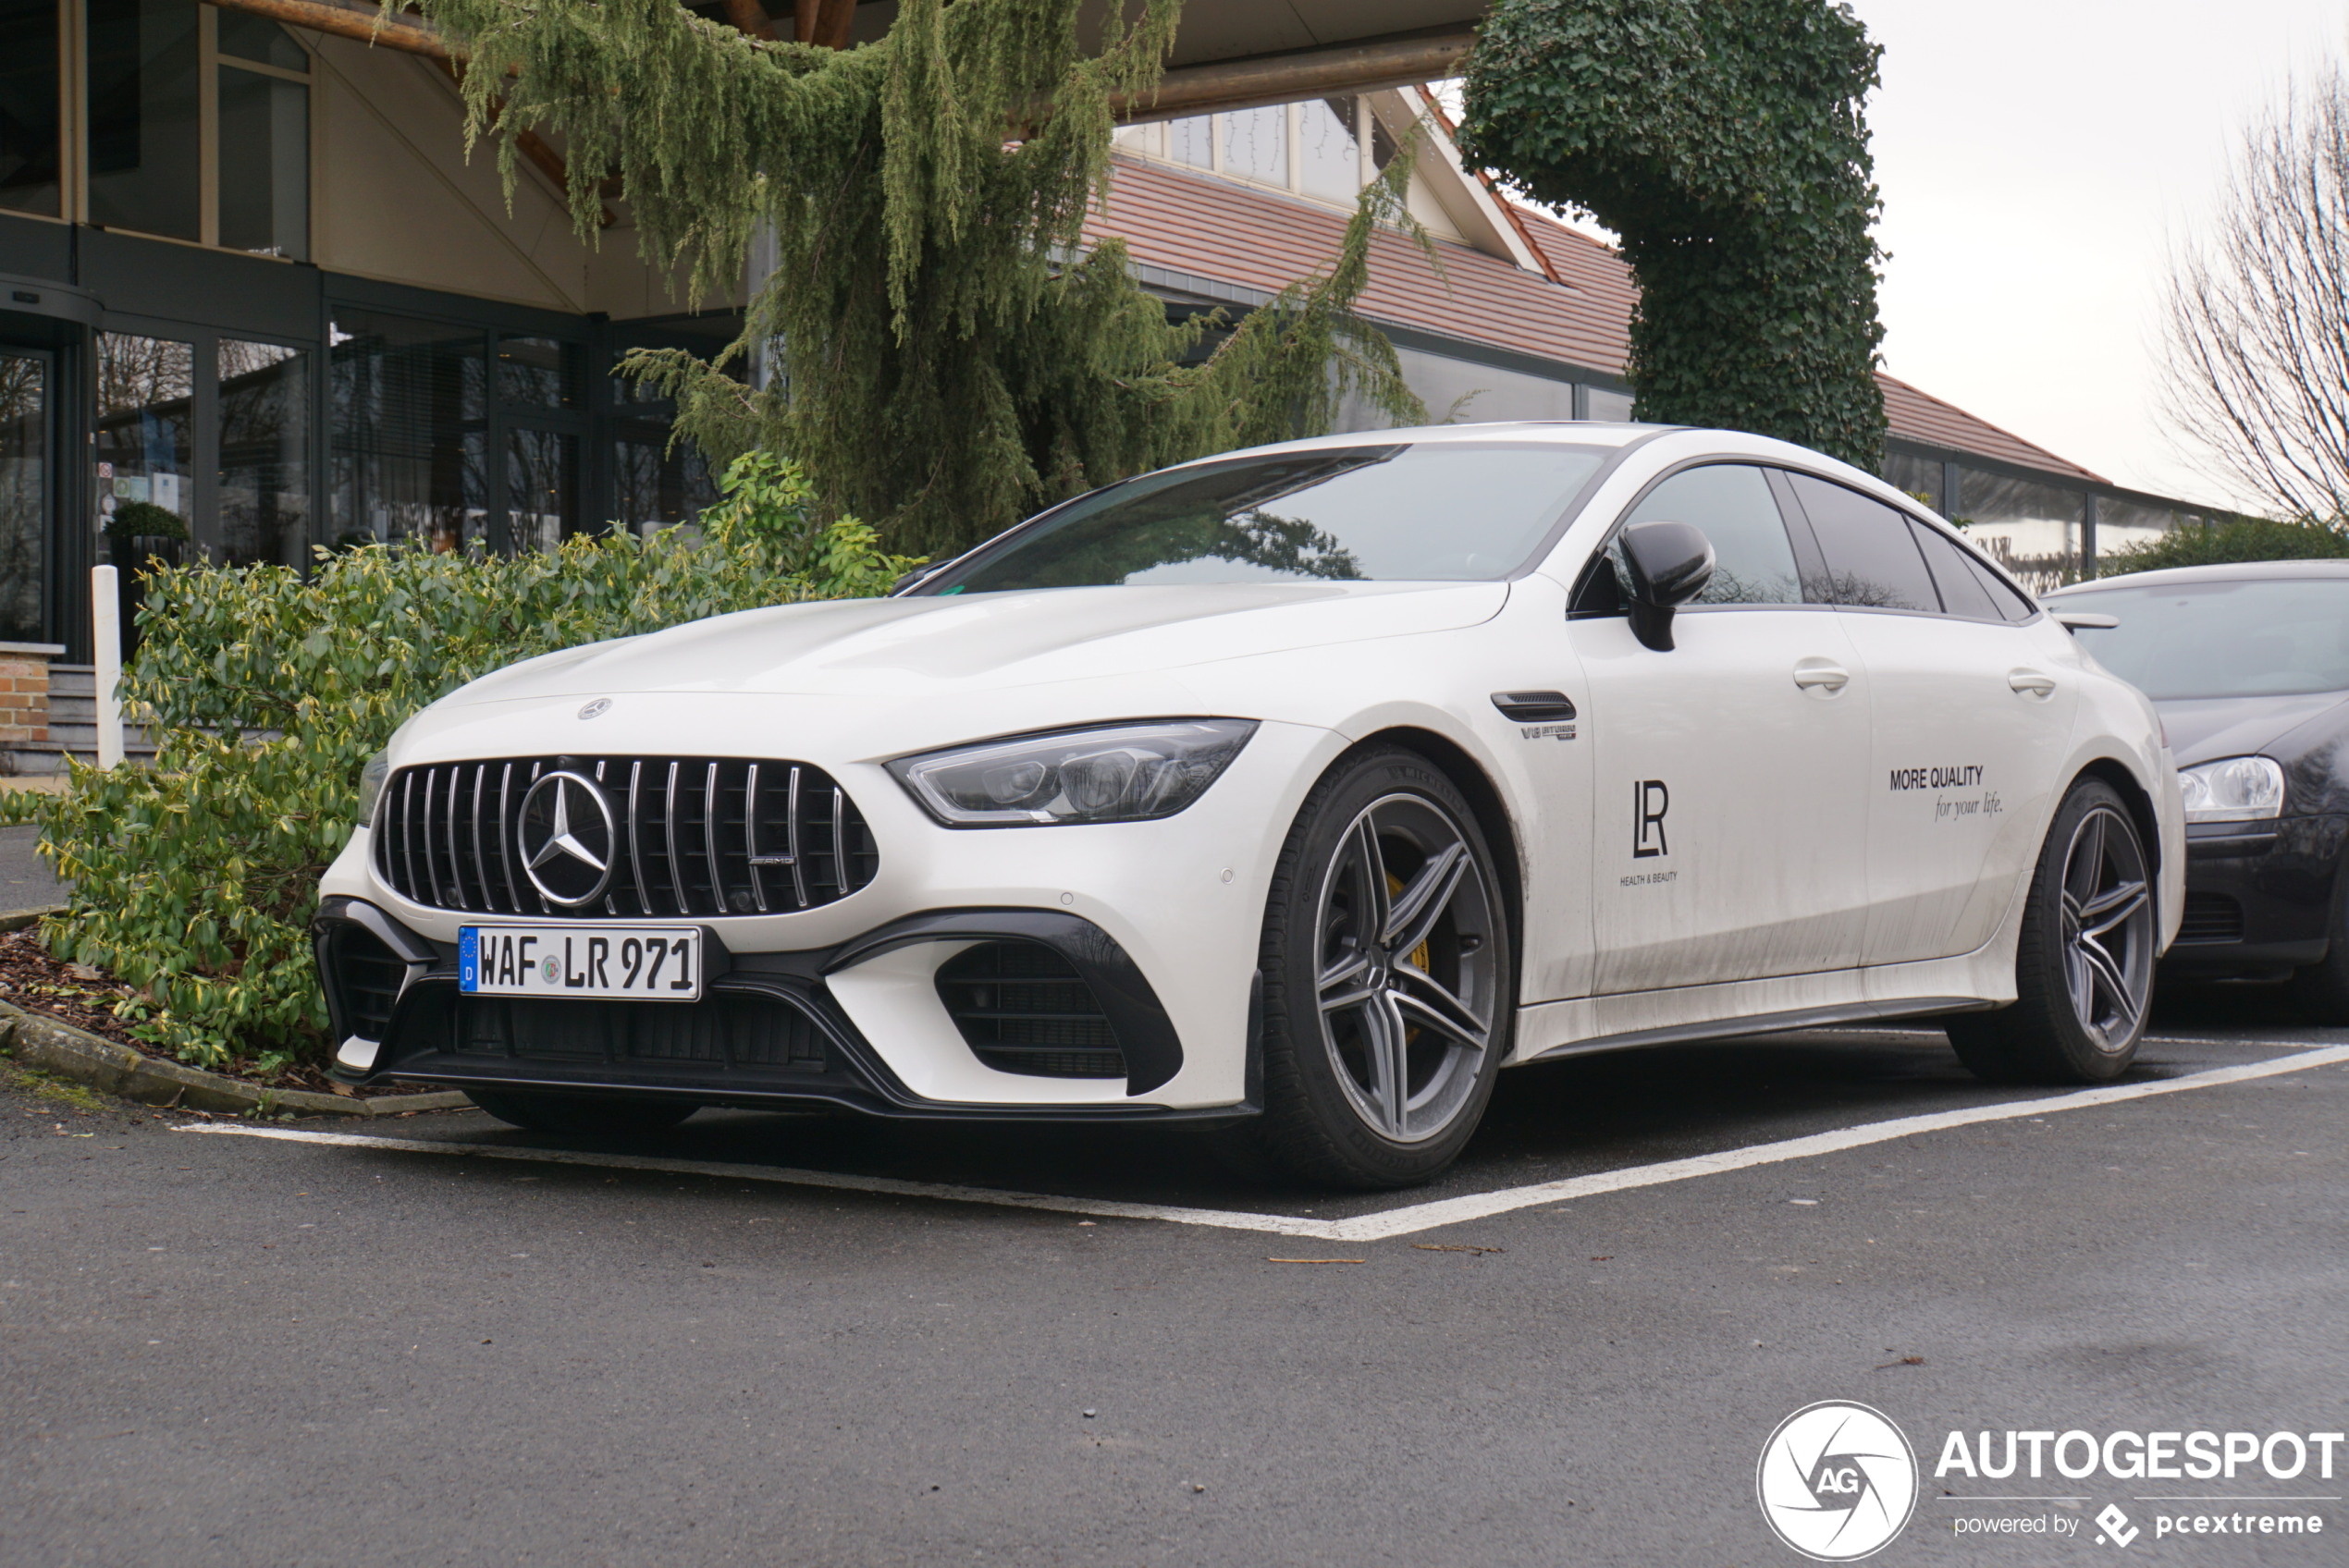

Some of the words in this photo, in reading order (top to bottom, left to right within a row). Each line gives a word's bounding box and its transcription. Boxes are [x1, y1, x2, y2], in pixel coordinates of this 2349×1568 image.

[1890, 768, 1927, 790] MORE
[1930, 766, 1983, 789] QUALITY
[1633, 779, 1668, 858] LR
[1935, 794, 1951, 823] for
[1954, 800, 1980, 821] your
[1983, 790, 2002, 818] life.
[1620, 875, 1645, 888] HEALTH
[1647, 874, 1651, 884] &
[1653, 871, 1678, 884] BEAUTY
[465, 967, 473, 981] D
[480, 936, 537, 986] WAF
[565, 937, 609, 988] LR
[621, 937, 694, 990] 971
